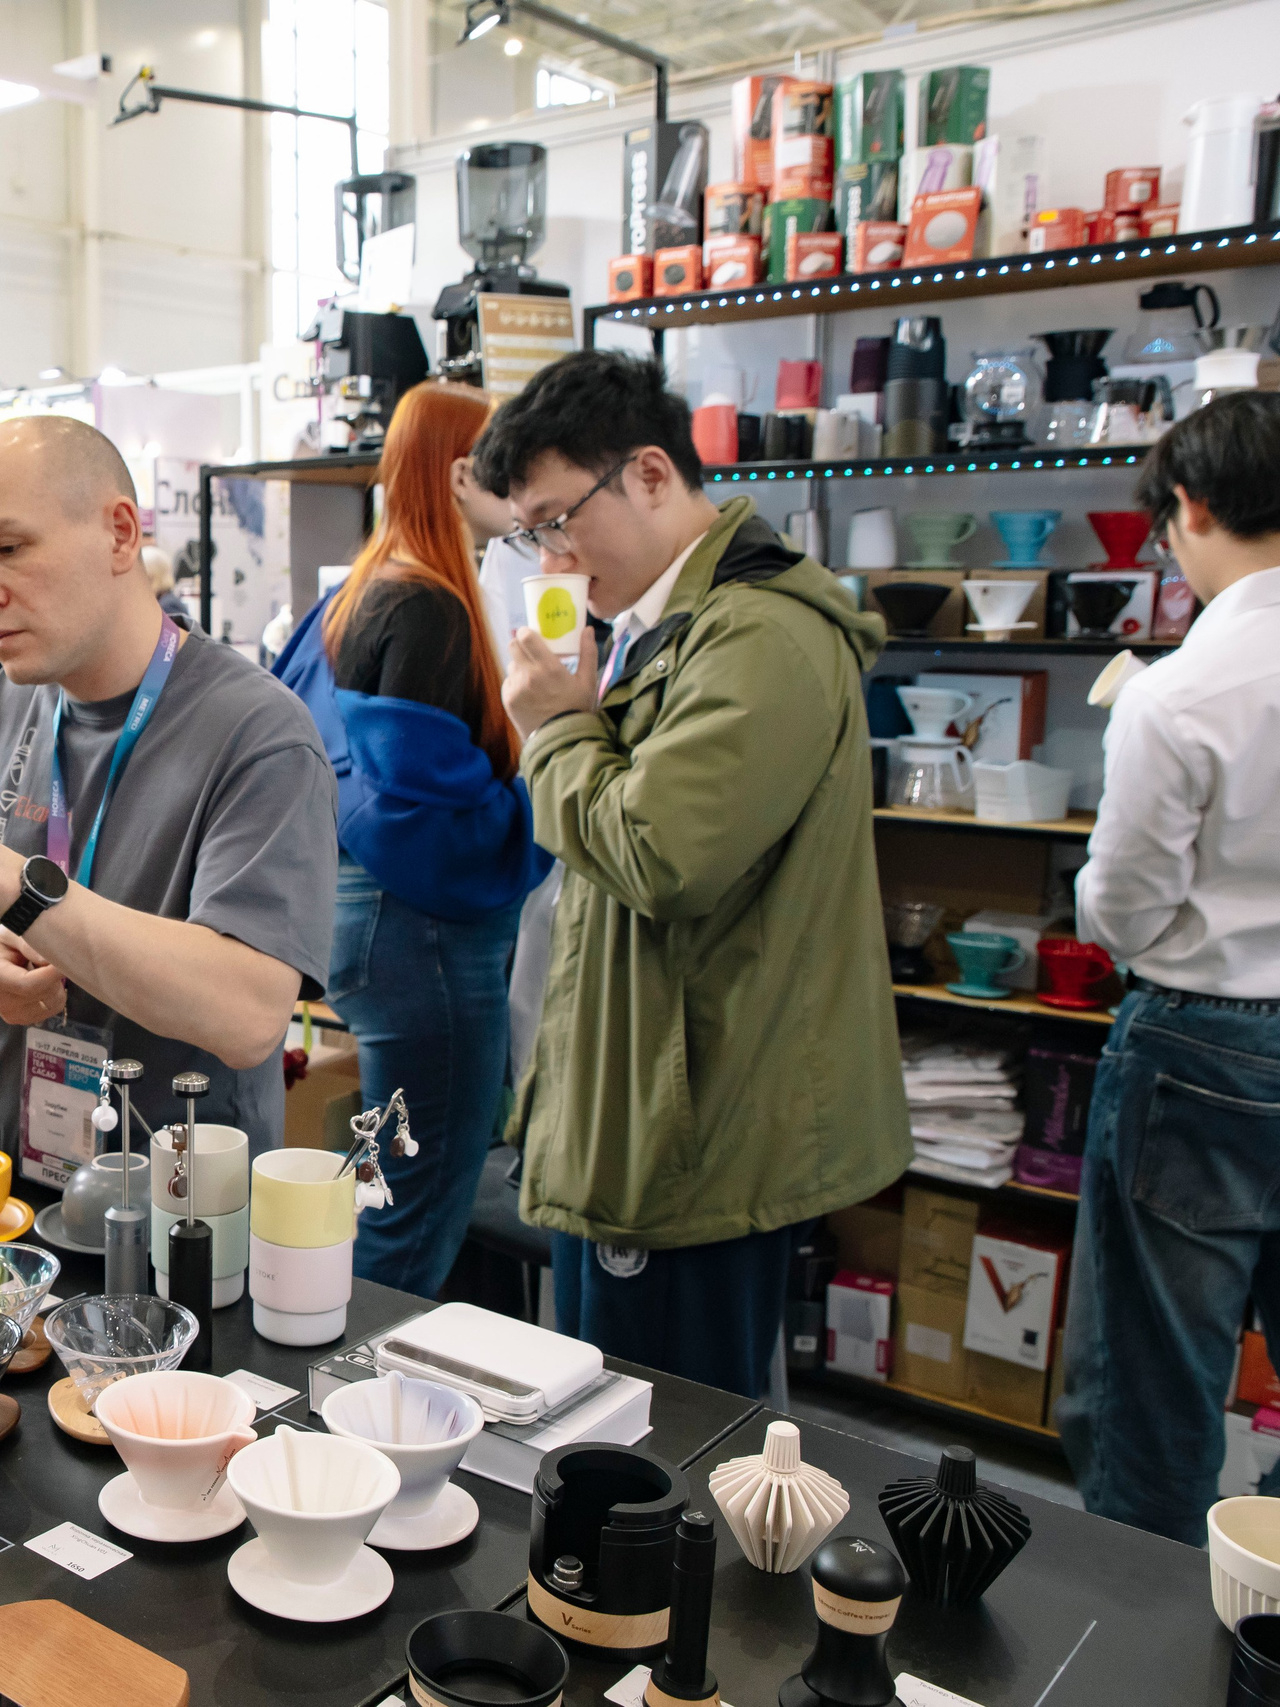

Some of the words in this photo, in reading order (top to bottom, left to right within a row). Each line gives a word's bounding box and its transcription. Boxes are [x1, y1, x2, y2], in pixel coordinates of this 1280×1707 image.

[631, 150, 648, 256] roPress
[131, 697, 150, 731] METRO
[51, 780, 60, 817] HORECA
[32, 1051, 57, 1064] COFFEE
[52, 1046, 80, 1059] АПРЕЛЯ
[81, 1053, 98, 1064] 2026
[32, 1059, 45, 1069] TEA
[68, 1063, 100, 1079] HORECA
[31, 1066, 57, 1080] CACAO
[67, 1561, 85, 1573] 1650
[837, 1608, 863, 1620] Coffee
[561, 1612, 573, 1626] V
[571, 1623, 592, 1634] Series
[920, 1681, 949, 1697] Темпер
